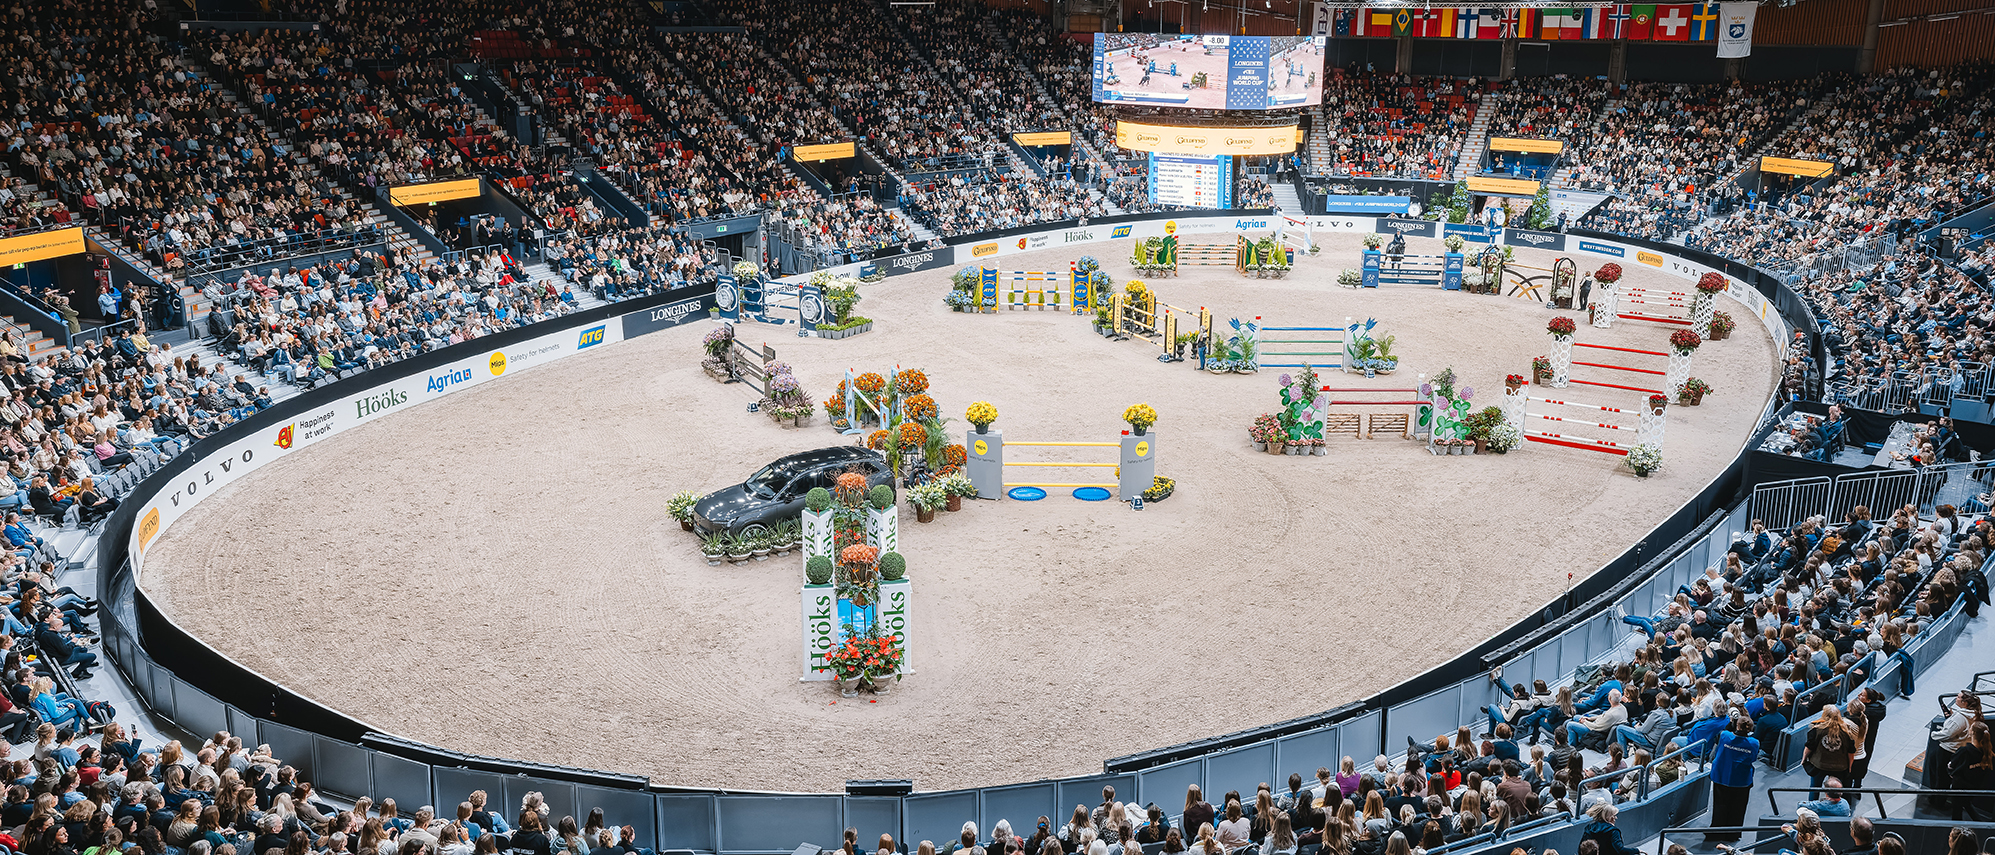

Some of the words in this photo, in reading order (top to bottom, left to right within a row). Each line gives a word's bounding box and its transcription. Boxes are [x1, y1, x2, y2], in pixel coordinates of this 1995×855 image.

[1112, 227, 1130, 236] ATG
[1236, 219, 1259, 231] Agria
[1287, 220, 1354, 229] VLVO
[1387, 221, 1425, 231] LONGINES
[1064, 230, 1093, 243] Hööks
[1516, 232, 1554, 243] LONGINES
[892, 252, 934, 268] LONGINES
[651, 300, 701, 322] LONGINES
[579, 329, 603, 346] ATG
[491, 360, 505, 368] Mips
[509, 352, 528, 363] Safety
[529, 349, 538, 358] for
[538, 343, 560, 355] helmets
[427, 369, 463, 393] Agria
[355, 388, 408, 420] Hööks
[299, 410, 335, 429] Happiness
[304, 430, 313, 440] at
[170, 449, 254, 507] VOLVO
[809, 595, 832, 674] Hööks
[884, 591, 905, 663] ööks
